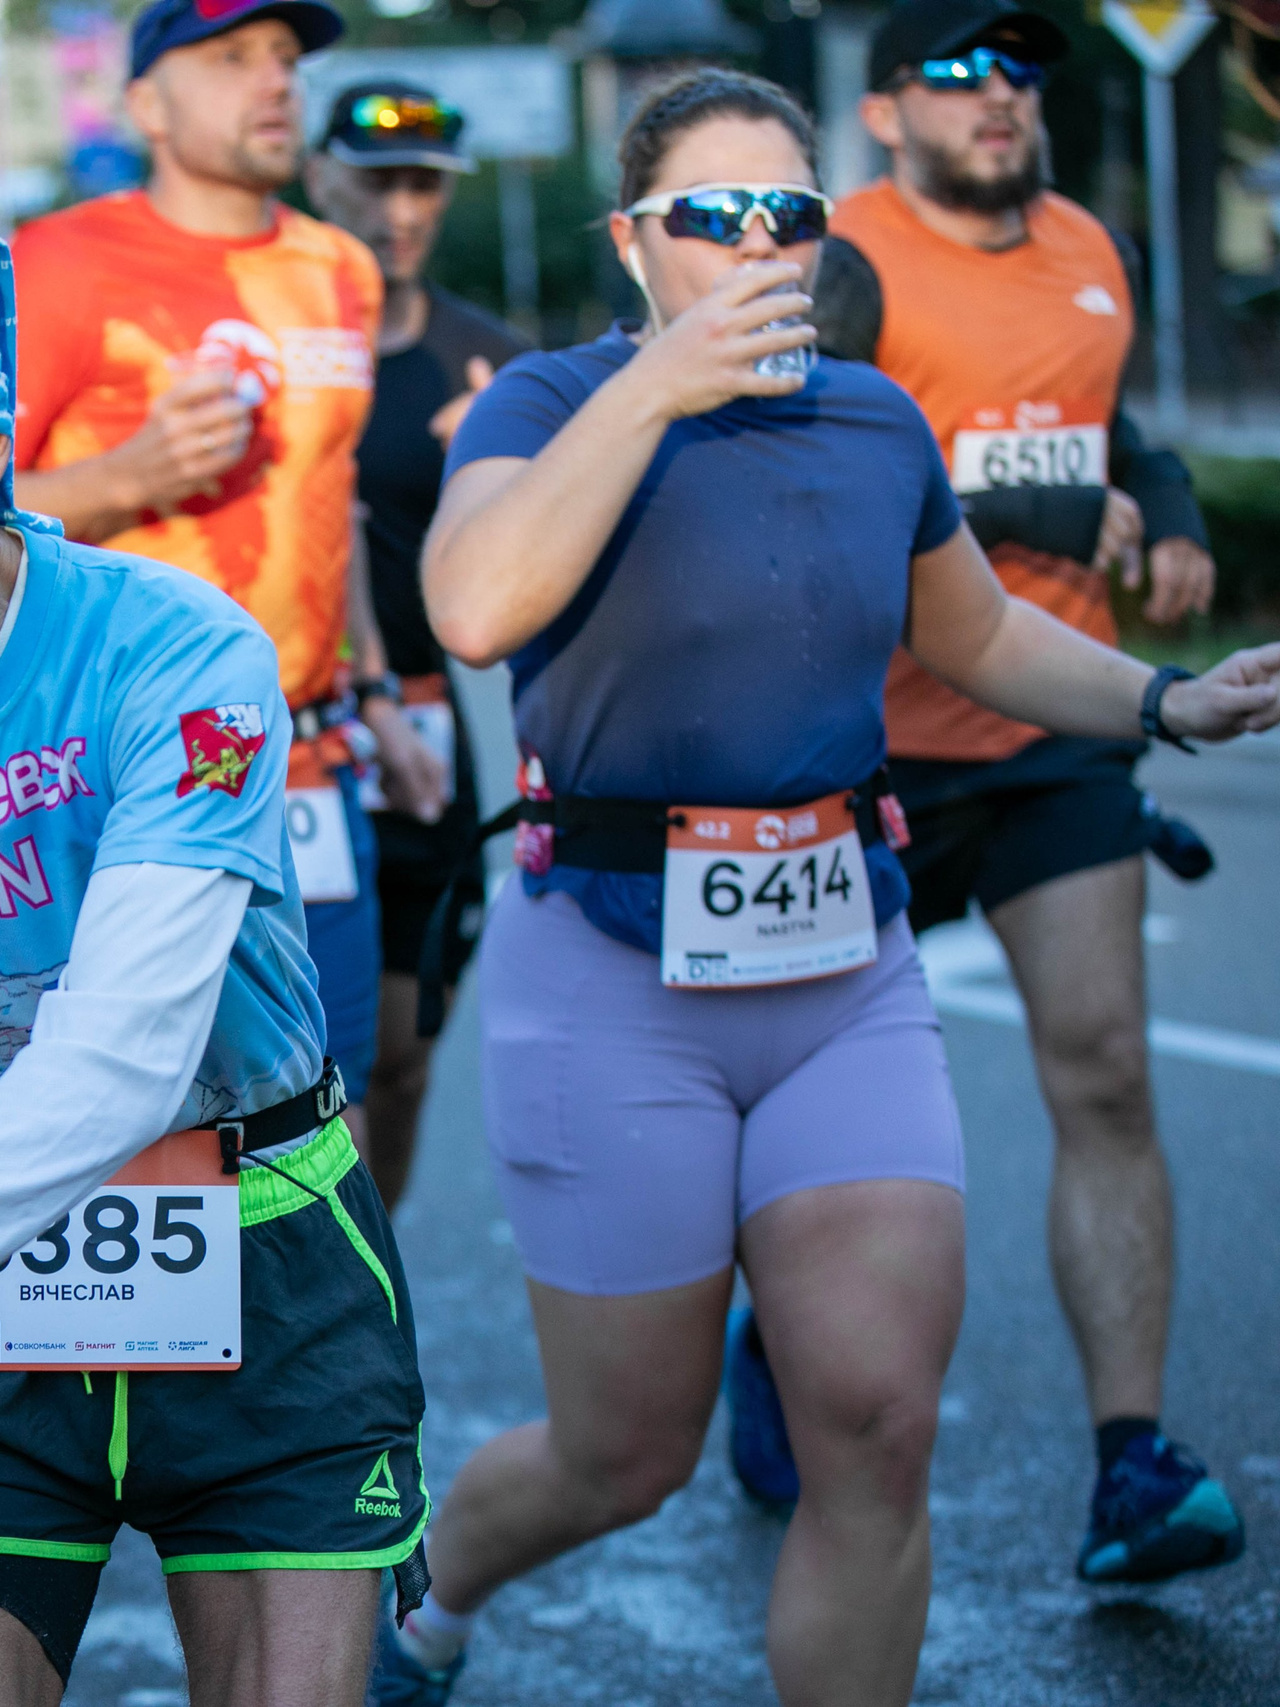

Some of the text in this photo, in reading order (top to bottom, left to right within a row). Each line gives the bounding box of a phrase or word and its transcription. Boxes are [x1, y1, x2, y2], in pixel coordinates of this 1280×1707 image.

[983, 436, 1087, 487] 6510
[701, 846, 852, 918] 6414
[20, 1284, 135, 1301] ВЯЧЕСЛАВ
[14, 1342, 67, 1350] СОВКОМБАНК
[86, 1342, 116, 1350] МАГНИТ
[355, 1498, 402, 1518] Reebok
